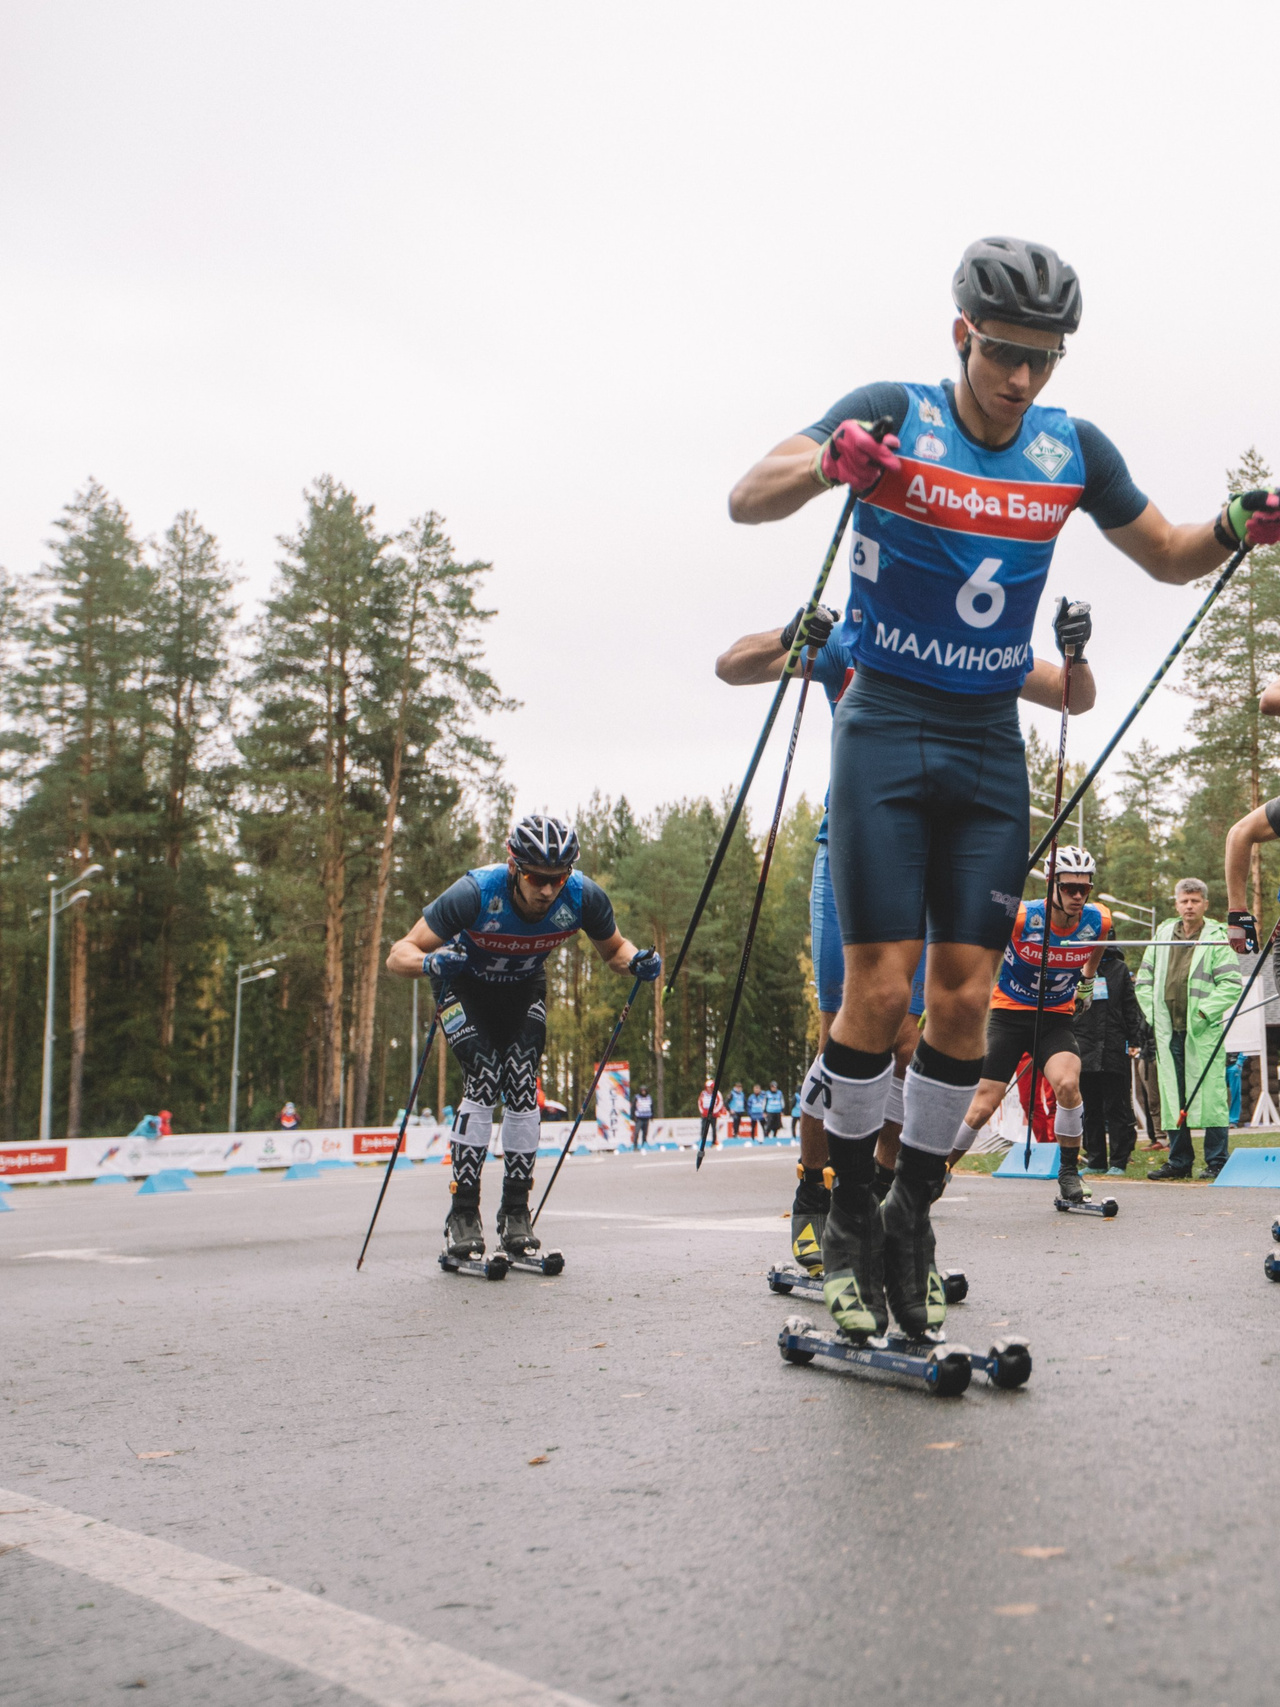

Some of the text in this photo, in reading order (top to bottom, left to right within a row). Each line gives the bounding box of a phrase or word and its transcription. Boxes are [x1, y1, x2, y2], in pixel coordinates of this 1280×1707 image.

[905, 474, 1069, 523] Альфа Банк
[853, 541, 866, 566] 6
[956, 558, 1005, 629] 6
[875, 622, 1029, 671] МАЛИНОВКА
[474, 937, 530, 951] Альфа
[1065, 951, 1093, 962] Банк
[486, 956, 537, 972] 11
[609, 1088, 619, 1138] СТАРТ
